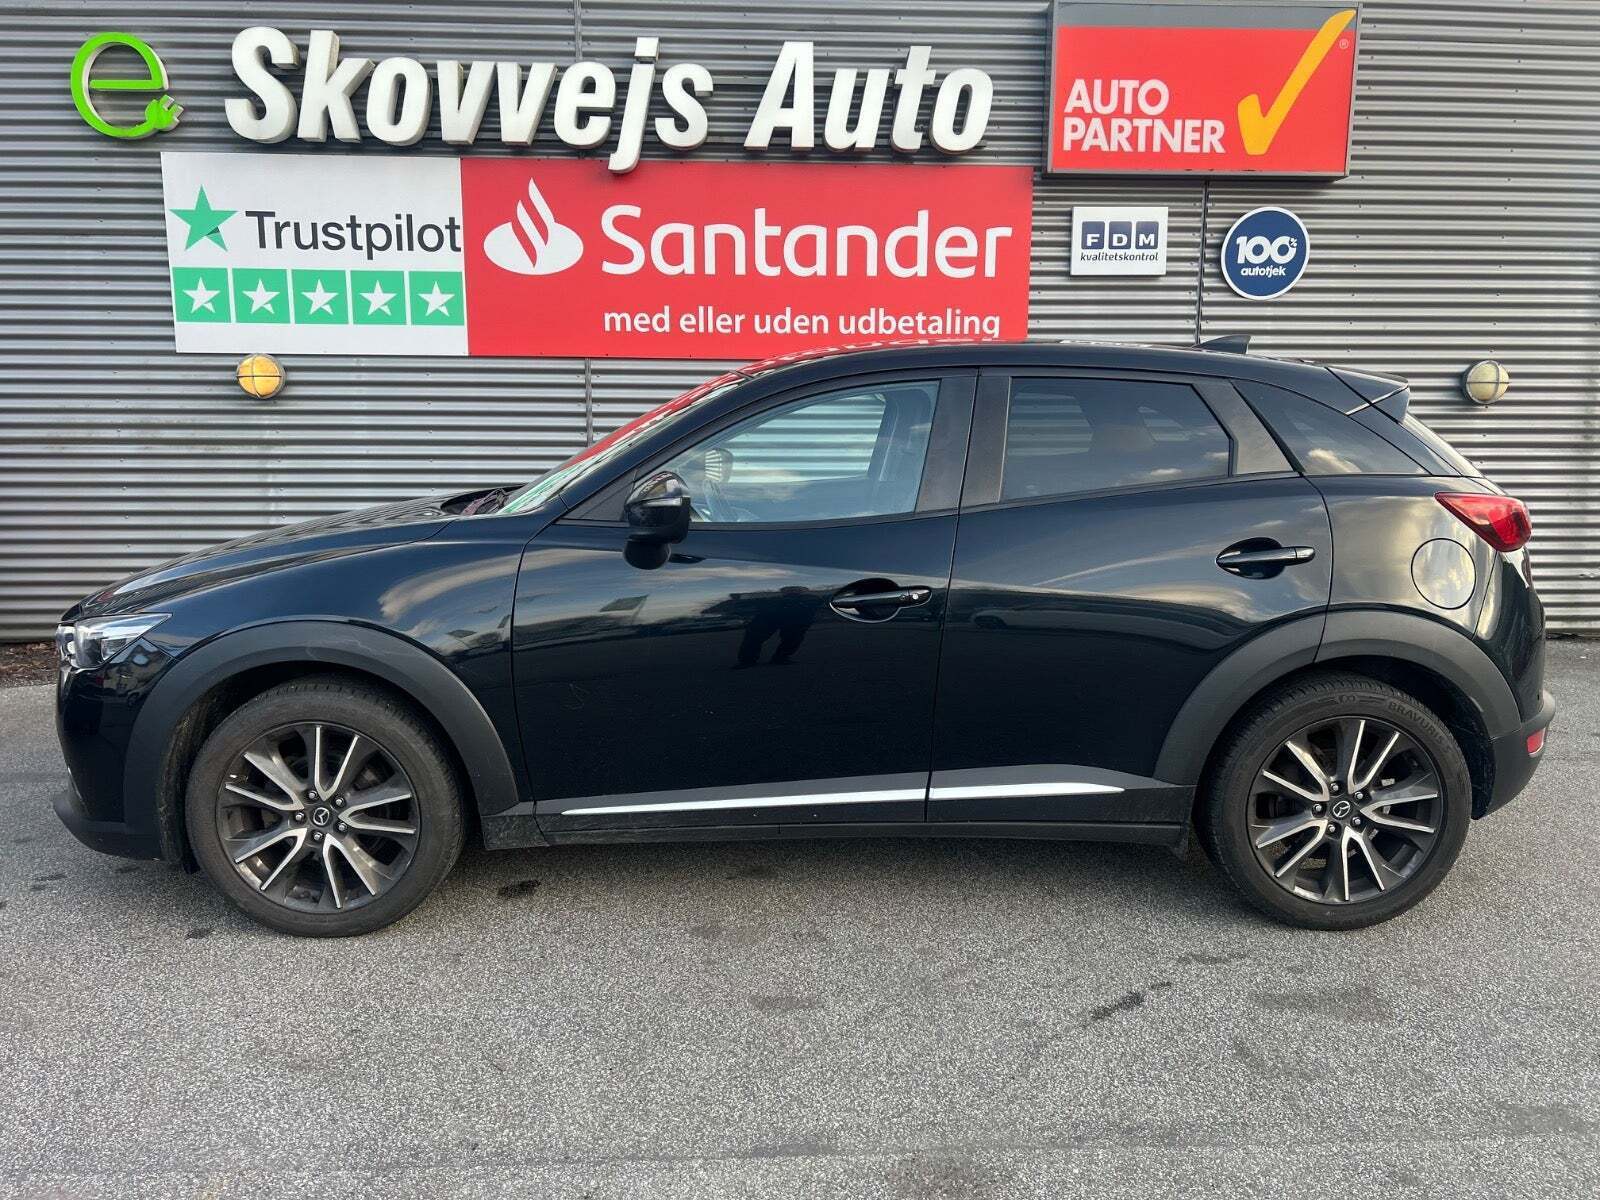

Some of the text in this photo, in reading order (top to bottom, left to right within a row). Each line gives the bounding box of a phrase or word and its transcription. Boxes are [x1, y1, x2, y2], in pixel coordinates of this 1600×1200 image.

[225, 26, 995, 173] Skovvejs Auto
[1064, 79, 1169, 115] AUTO
[1062, 117, 1226, 154] PARTNER
[245, 210, 462, 260] Trustpilot
[601, 204, 1013, 279] Santander
[1086, 233, 1155, 247] FDM
[1080, 251, 1159, 261] kvalitetskontrol
[1240, 265, 1287, 278] autotjek
[603, 305, 1001, 339] med eller uden udbetaling
